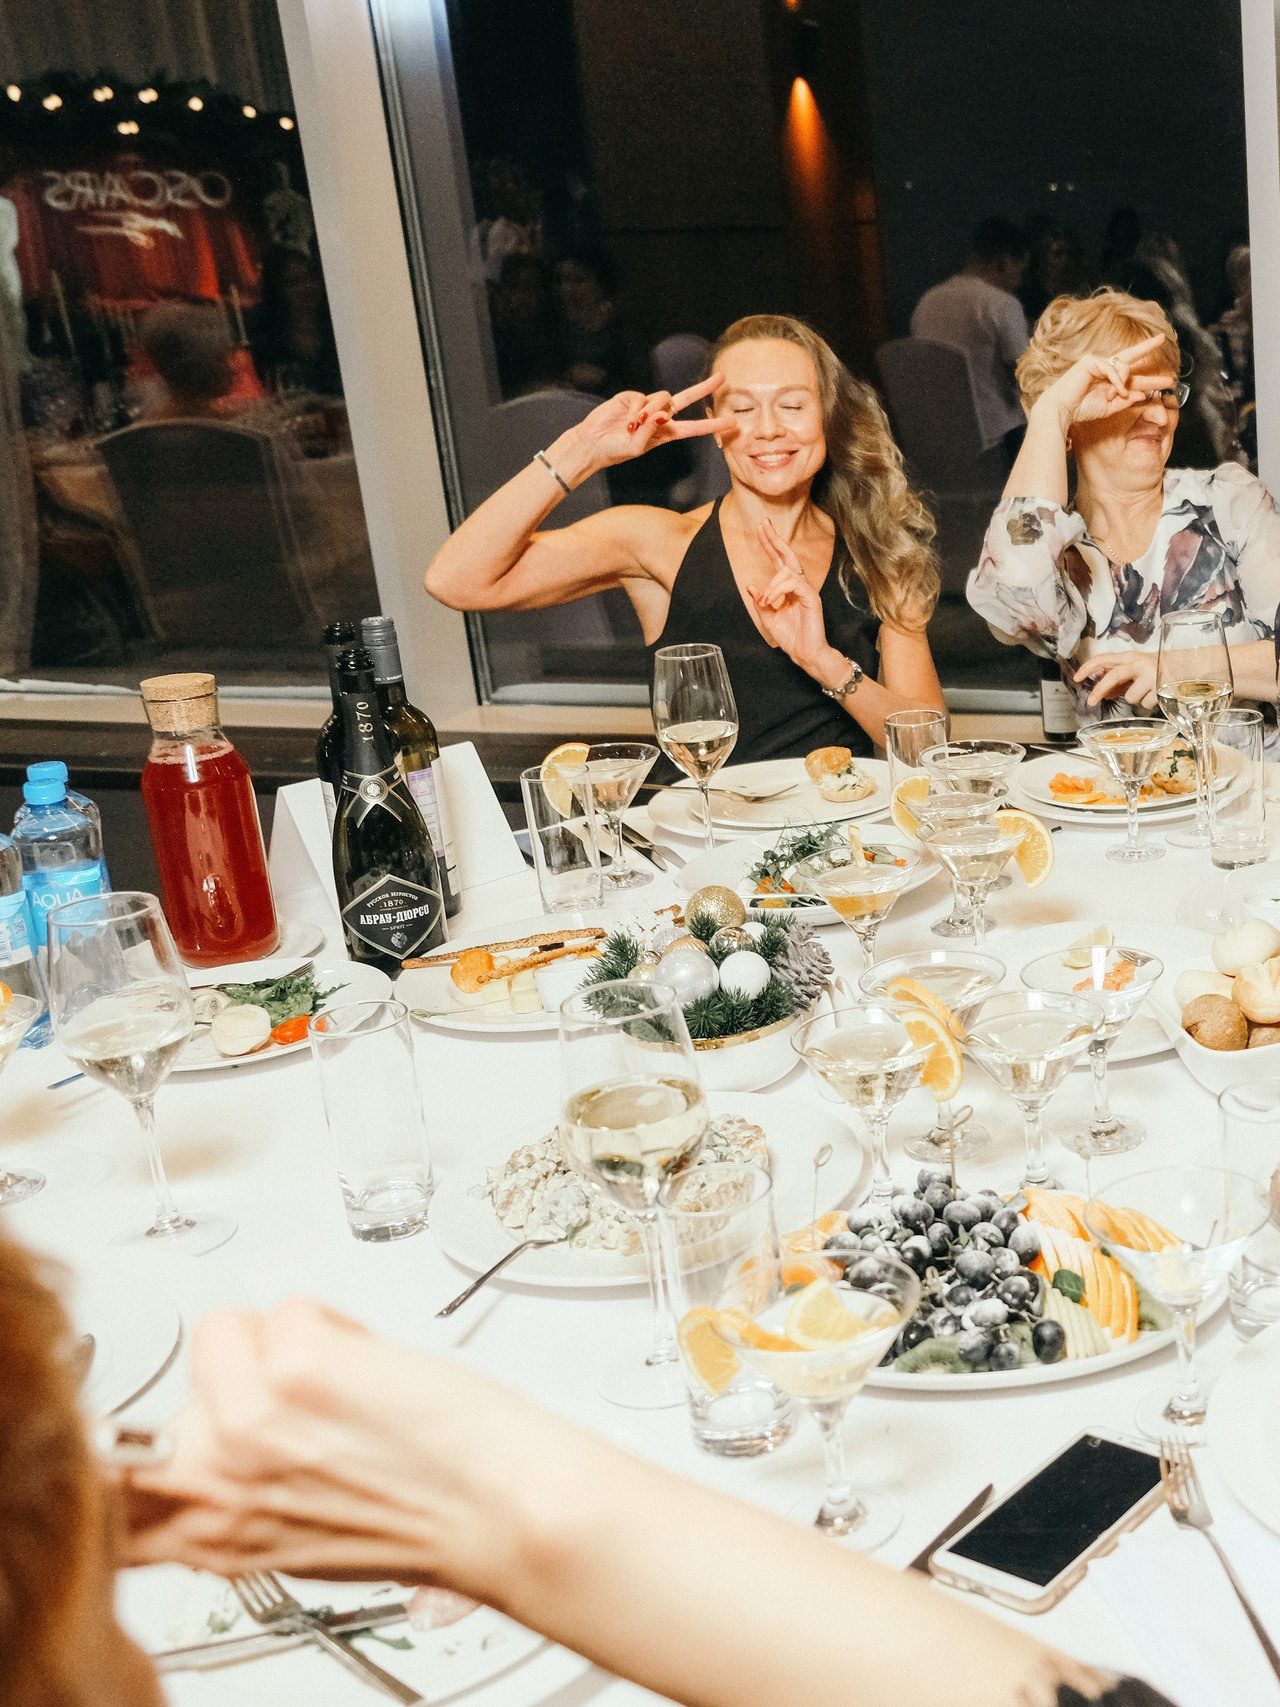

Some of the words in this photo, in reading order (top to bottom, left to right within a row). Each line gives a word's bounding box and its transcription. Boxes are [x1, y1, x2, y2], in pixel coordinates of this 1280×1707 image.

[356, 702, 374, 743] 1870
[32, 888, 84, 909] AQUA
[360, 904, 430, 925] АБРАУ-ДЮРСО
